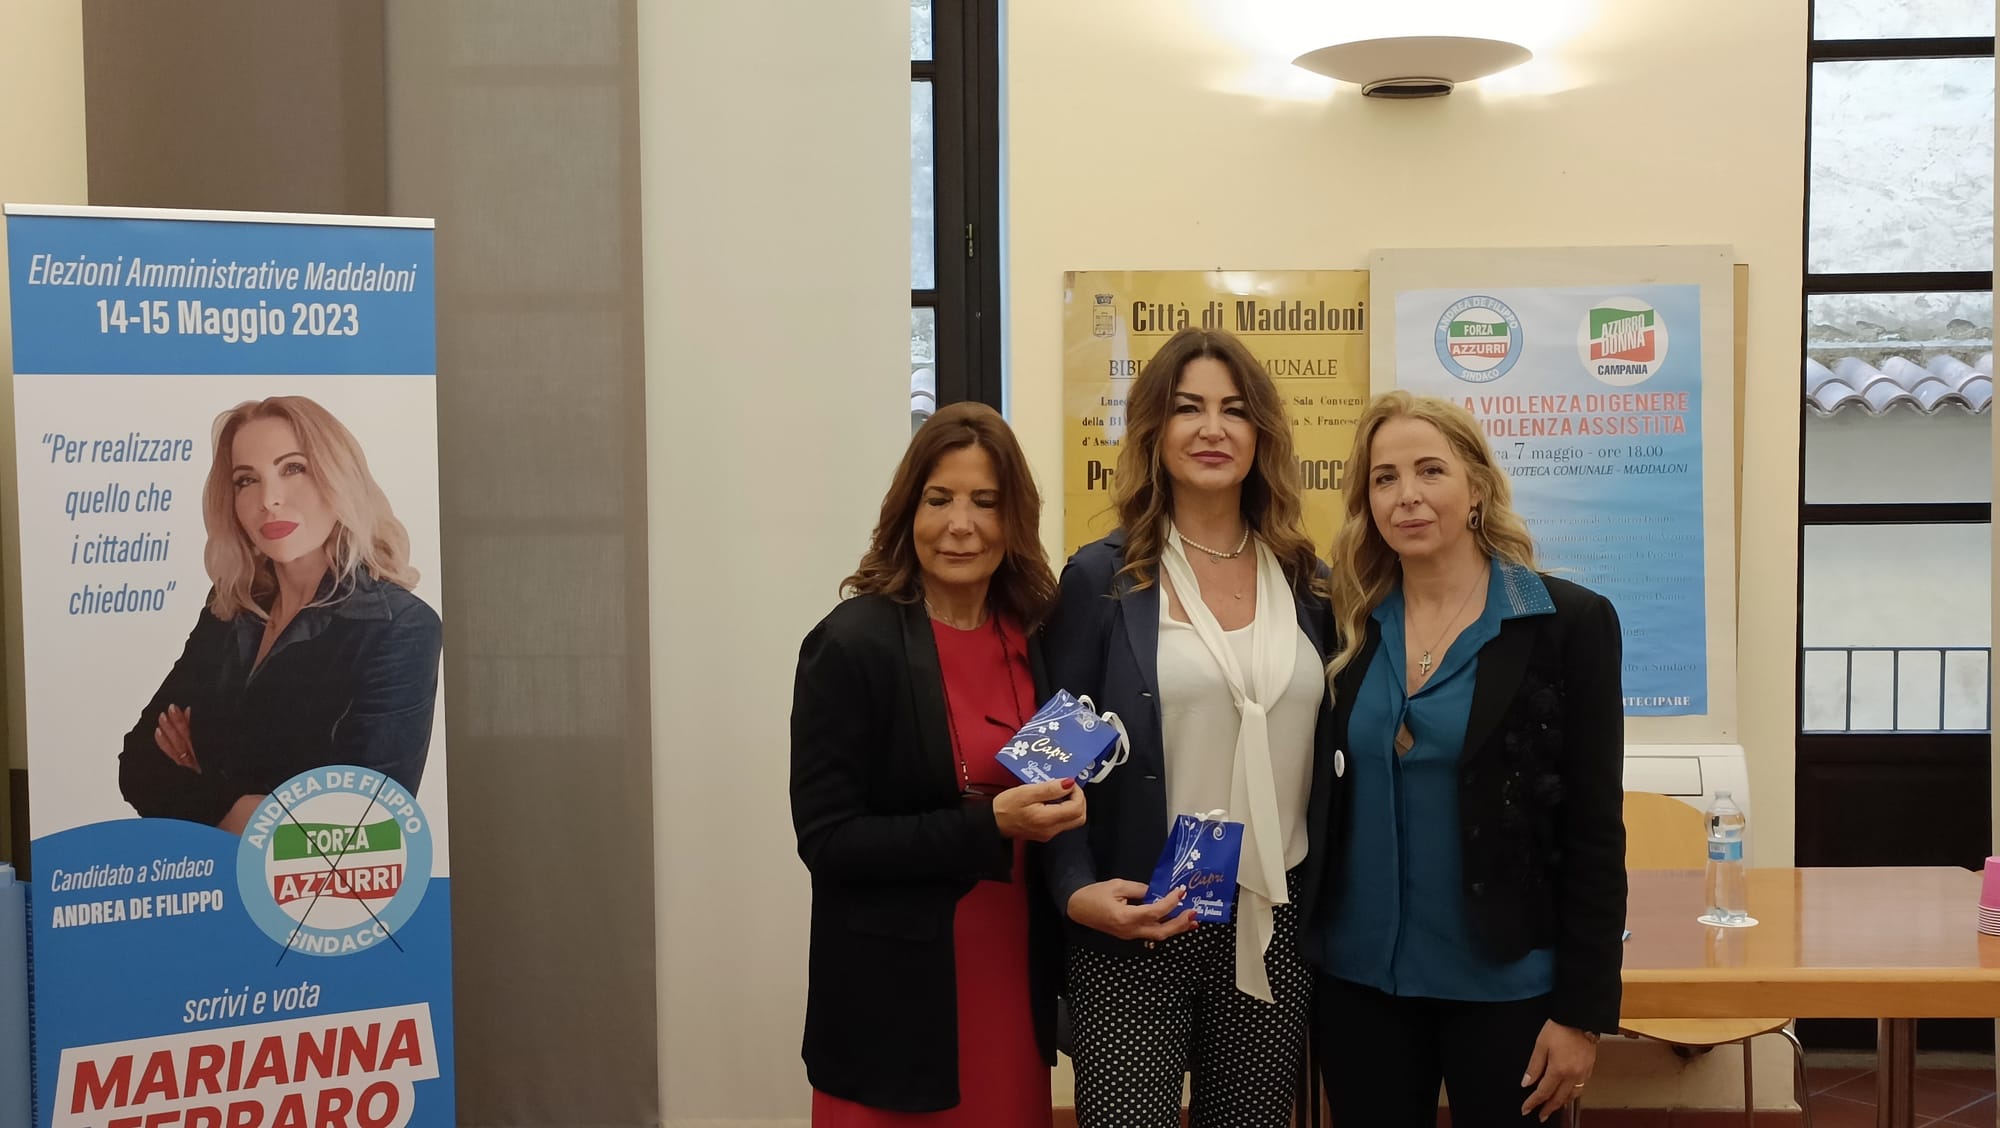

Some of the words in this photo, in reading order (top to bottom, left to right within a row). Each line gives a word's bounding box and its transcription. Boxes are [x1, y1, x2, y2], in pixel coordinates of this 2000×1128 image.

[28, 253, 123, 287] Elezioni
[125, 257, 299, 290] Amministrative
[304, 261, 417, 292] Maddaloni
[96, 300, 170, 335] 14-15
[177, 300, 286, 344] Maggio
[292, 302, 359, 336] 2023
[1132, 300, 1190, 331] Città
[1202, 301, 1223, 330] di
[1236, 300, 1364, 332] Maddaloni
[1438, 299, 1471, 332] ANDREA
[1472, 297, 1487, 307] DE
[1487, 299, 1519, 329] FILIPPO
[1464, 324, 1494, 336] FORZA
[1601, 313, 1645, 339] AZZURRO
[1452, 343, 1505, 355] AZZURRI
[1601, 330, 1646, 357] DONNA
[1260, 359, 1338, 376] MUNALE
[1461, 368, 1500, 381] SINDACO
[1597, 364, 1648, 376] CAMPANIA
[1480, 394, 1582, 415] VIOLENZA
[1586, 394, 1605, 413] DI
[1608, 392, 1689, 412] GENERE
[1482, 417, 1573, 437] IOLENZA
[1578, 415, 1686, 436] ASSISTITA
[42, 433, 89, 463] “Per
[91, 432, 193, 463] realizzare
[1514, 442, 1525, 460] 7
[1531, 446, 1584, 463] maggio
[1598, 448, 1622, 459] ore
[1627, 445, 1664, 458] 18.00
[1087, 460, 1114, 490] Pr
[1300, 459, 1343, 490] OCC
[1506, 466, 1552, 477] LIOTECA
[1553, 464, 1614, 477] COMUNALE
[1623, 463, 1689, 475] MADDALONI
[65, 482, 130, 521] quello
[135, 482, 173, 513] che
[71, 534, 80, 565] i
[83, 531, 171, 564] cittadini
[69, 580, 177, 615] chiedono”
[1031, 737, 1073, 763] Capri
[248, 776, 322, 850] ANDREA
[326, 772, 356, 789] DE
[358, 775, 422, 834] FILIPPO
[306, 827, 370, 855] FORZA
[51, 864, 134, 893] Candidato
[137, 865, 148, 884] a
[151, 856, 215, 882] Sindaco
[278, 865, 398, 900] AZZURRI
[1188, 870, 1225, 890] Capri
[52, 899, 127, 929] ANDREA
[130, 896, 153, 921] DE
[156, 889, 224, 917] FILIPPO
[286, 920, 391, 954] SINDACO
[183, 985, 250, 1024] scrivi
[252, 991, 267, 1015] e
[273, 981, 321, 1013] vota
[70, 1018, 423, 1114] MARIANNA
[107, 1081, 401, 1128] RARO
